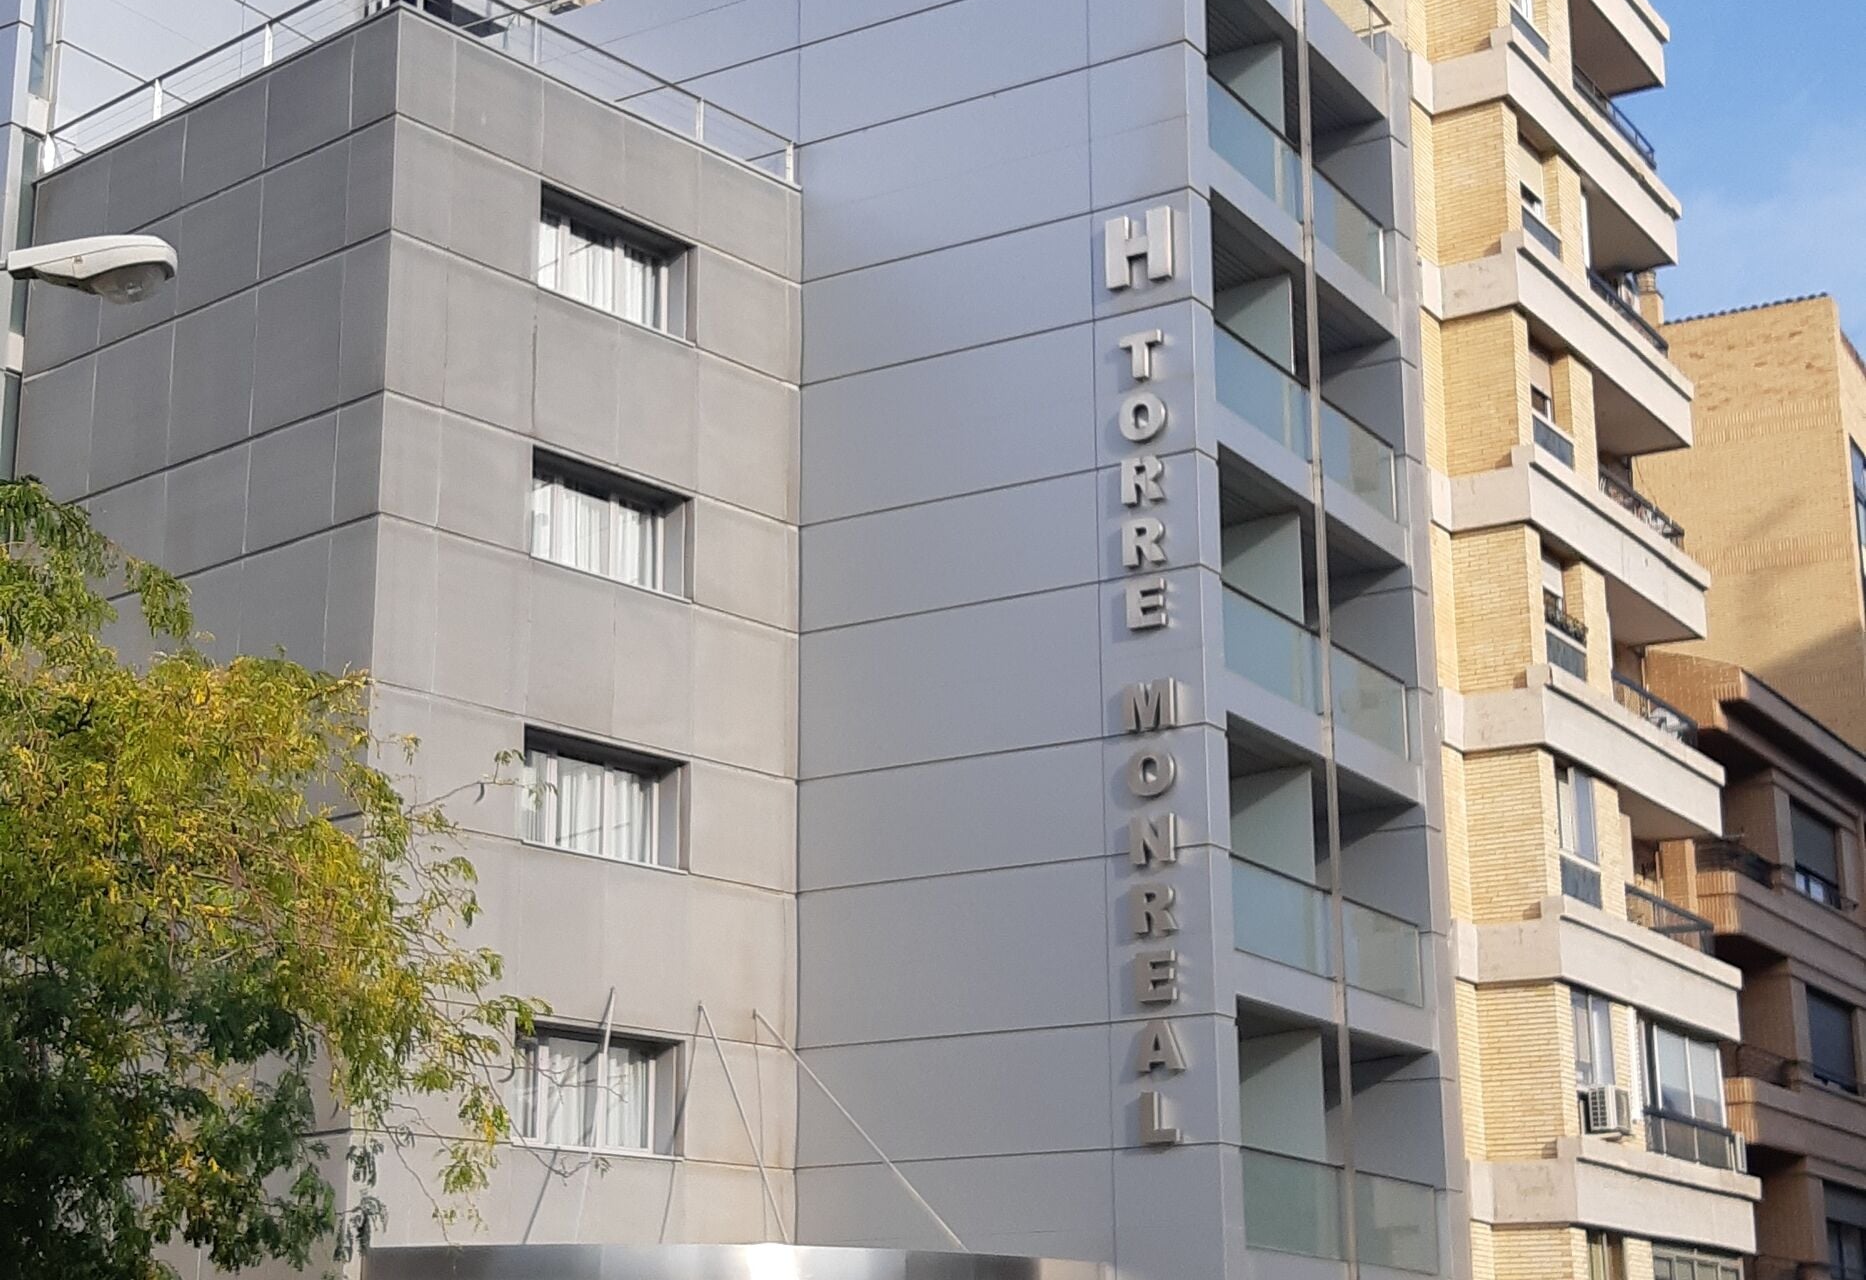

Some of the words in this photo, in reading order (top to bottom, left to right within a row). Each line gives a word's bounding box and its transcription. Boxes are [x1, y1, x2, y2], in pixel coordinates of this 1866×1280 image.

[1105, 205, 1172, 291] H
[1119, 328, 1169, 631] TORRE
[1123, 677, 1187, 1147] MONREAL
